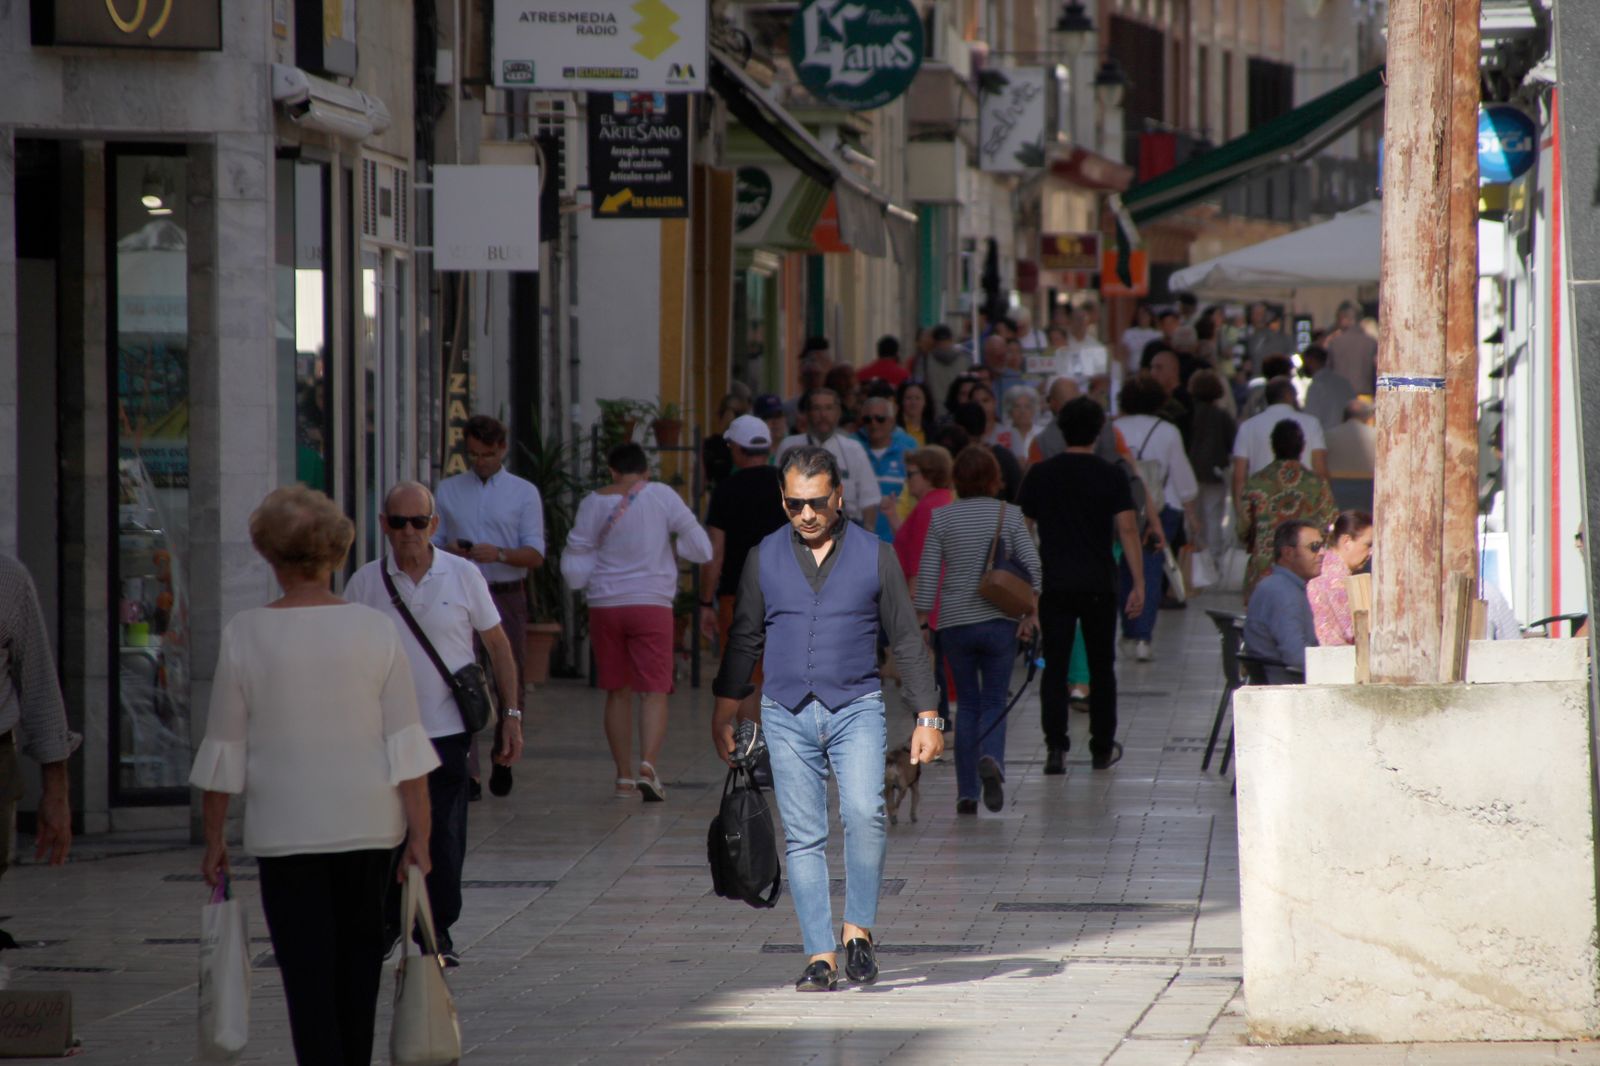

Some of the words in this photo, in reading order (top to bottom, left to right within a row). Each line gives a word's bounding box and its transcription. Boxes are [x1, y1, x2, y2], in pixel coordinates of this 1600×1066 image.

[519, 11, 616, 24] ATRESMEDIA
[576, 25, 617, 36] RADIO
[600, 114, 616, 125] EL
[24, 999, 64, 1018] UNA
